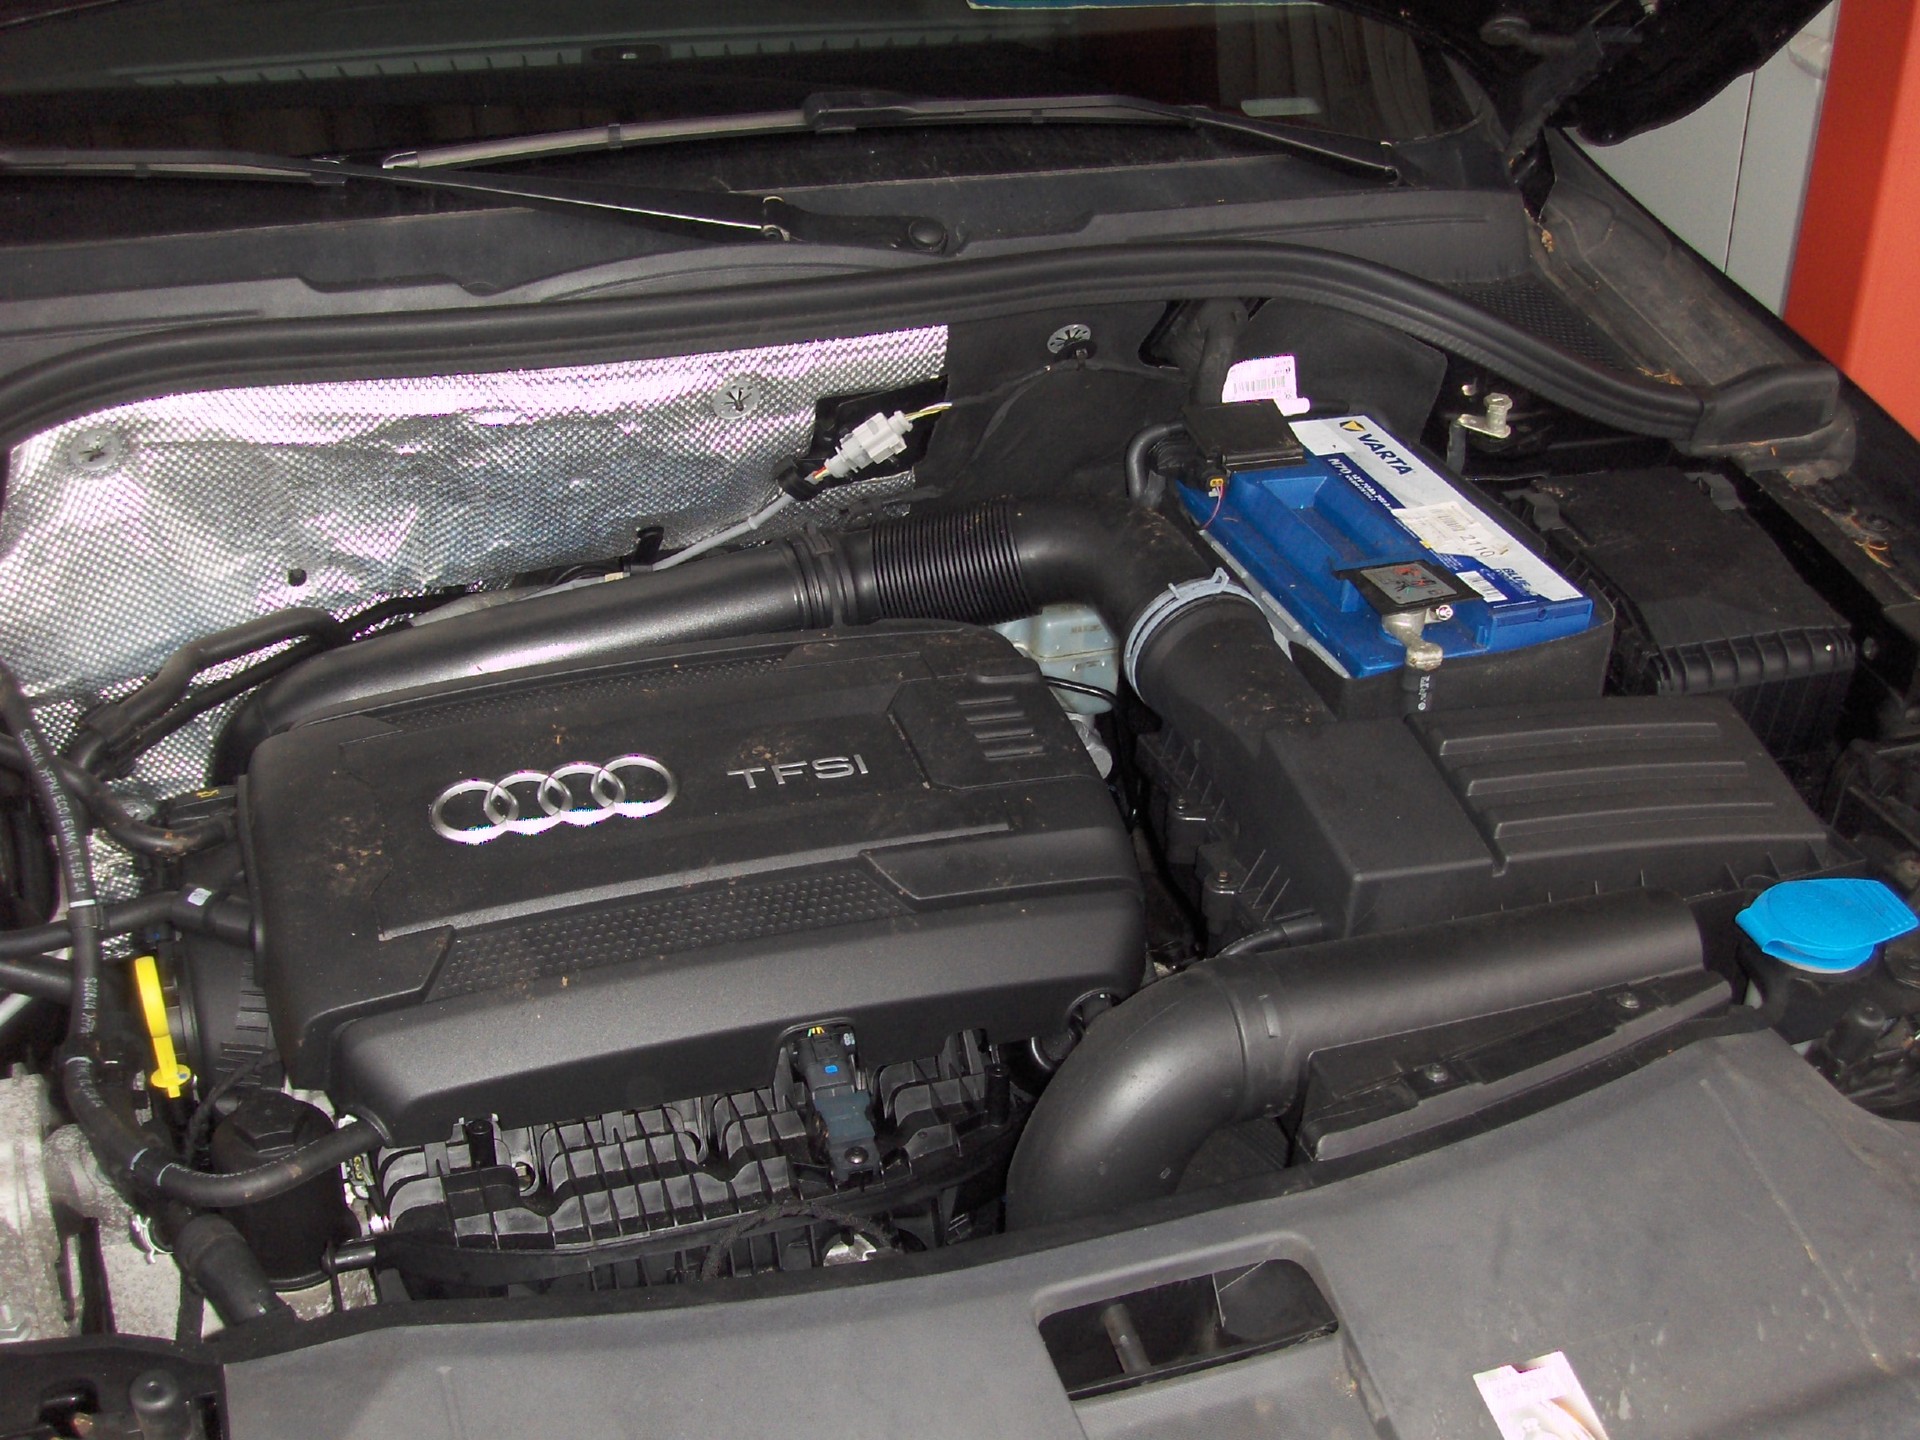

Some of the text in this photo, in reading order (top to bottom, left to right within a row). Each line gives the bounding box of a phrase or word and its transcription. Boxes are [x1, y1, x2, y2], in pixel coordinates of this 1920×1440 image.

[1328, 458, 1352, 475] N70
[1358, 433, 1414, 475] VARTA
[1460, 534, 1495, 558] 2110
[726, 753, 869, 790] TFSI
